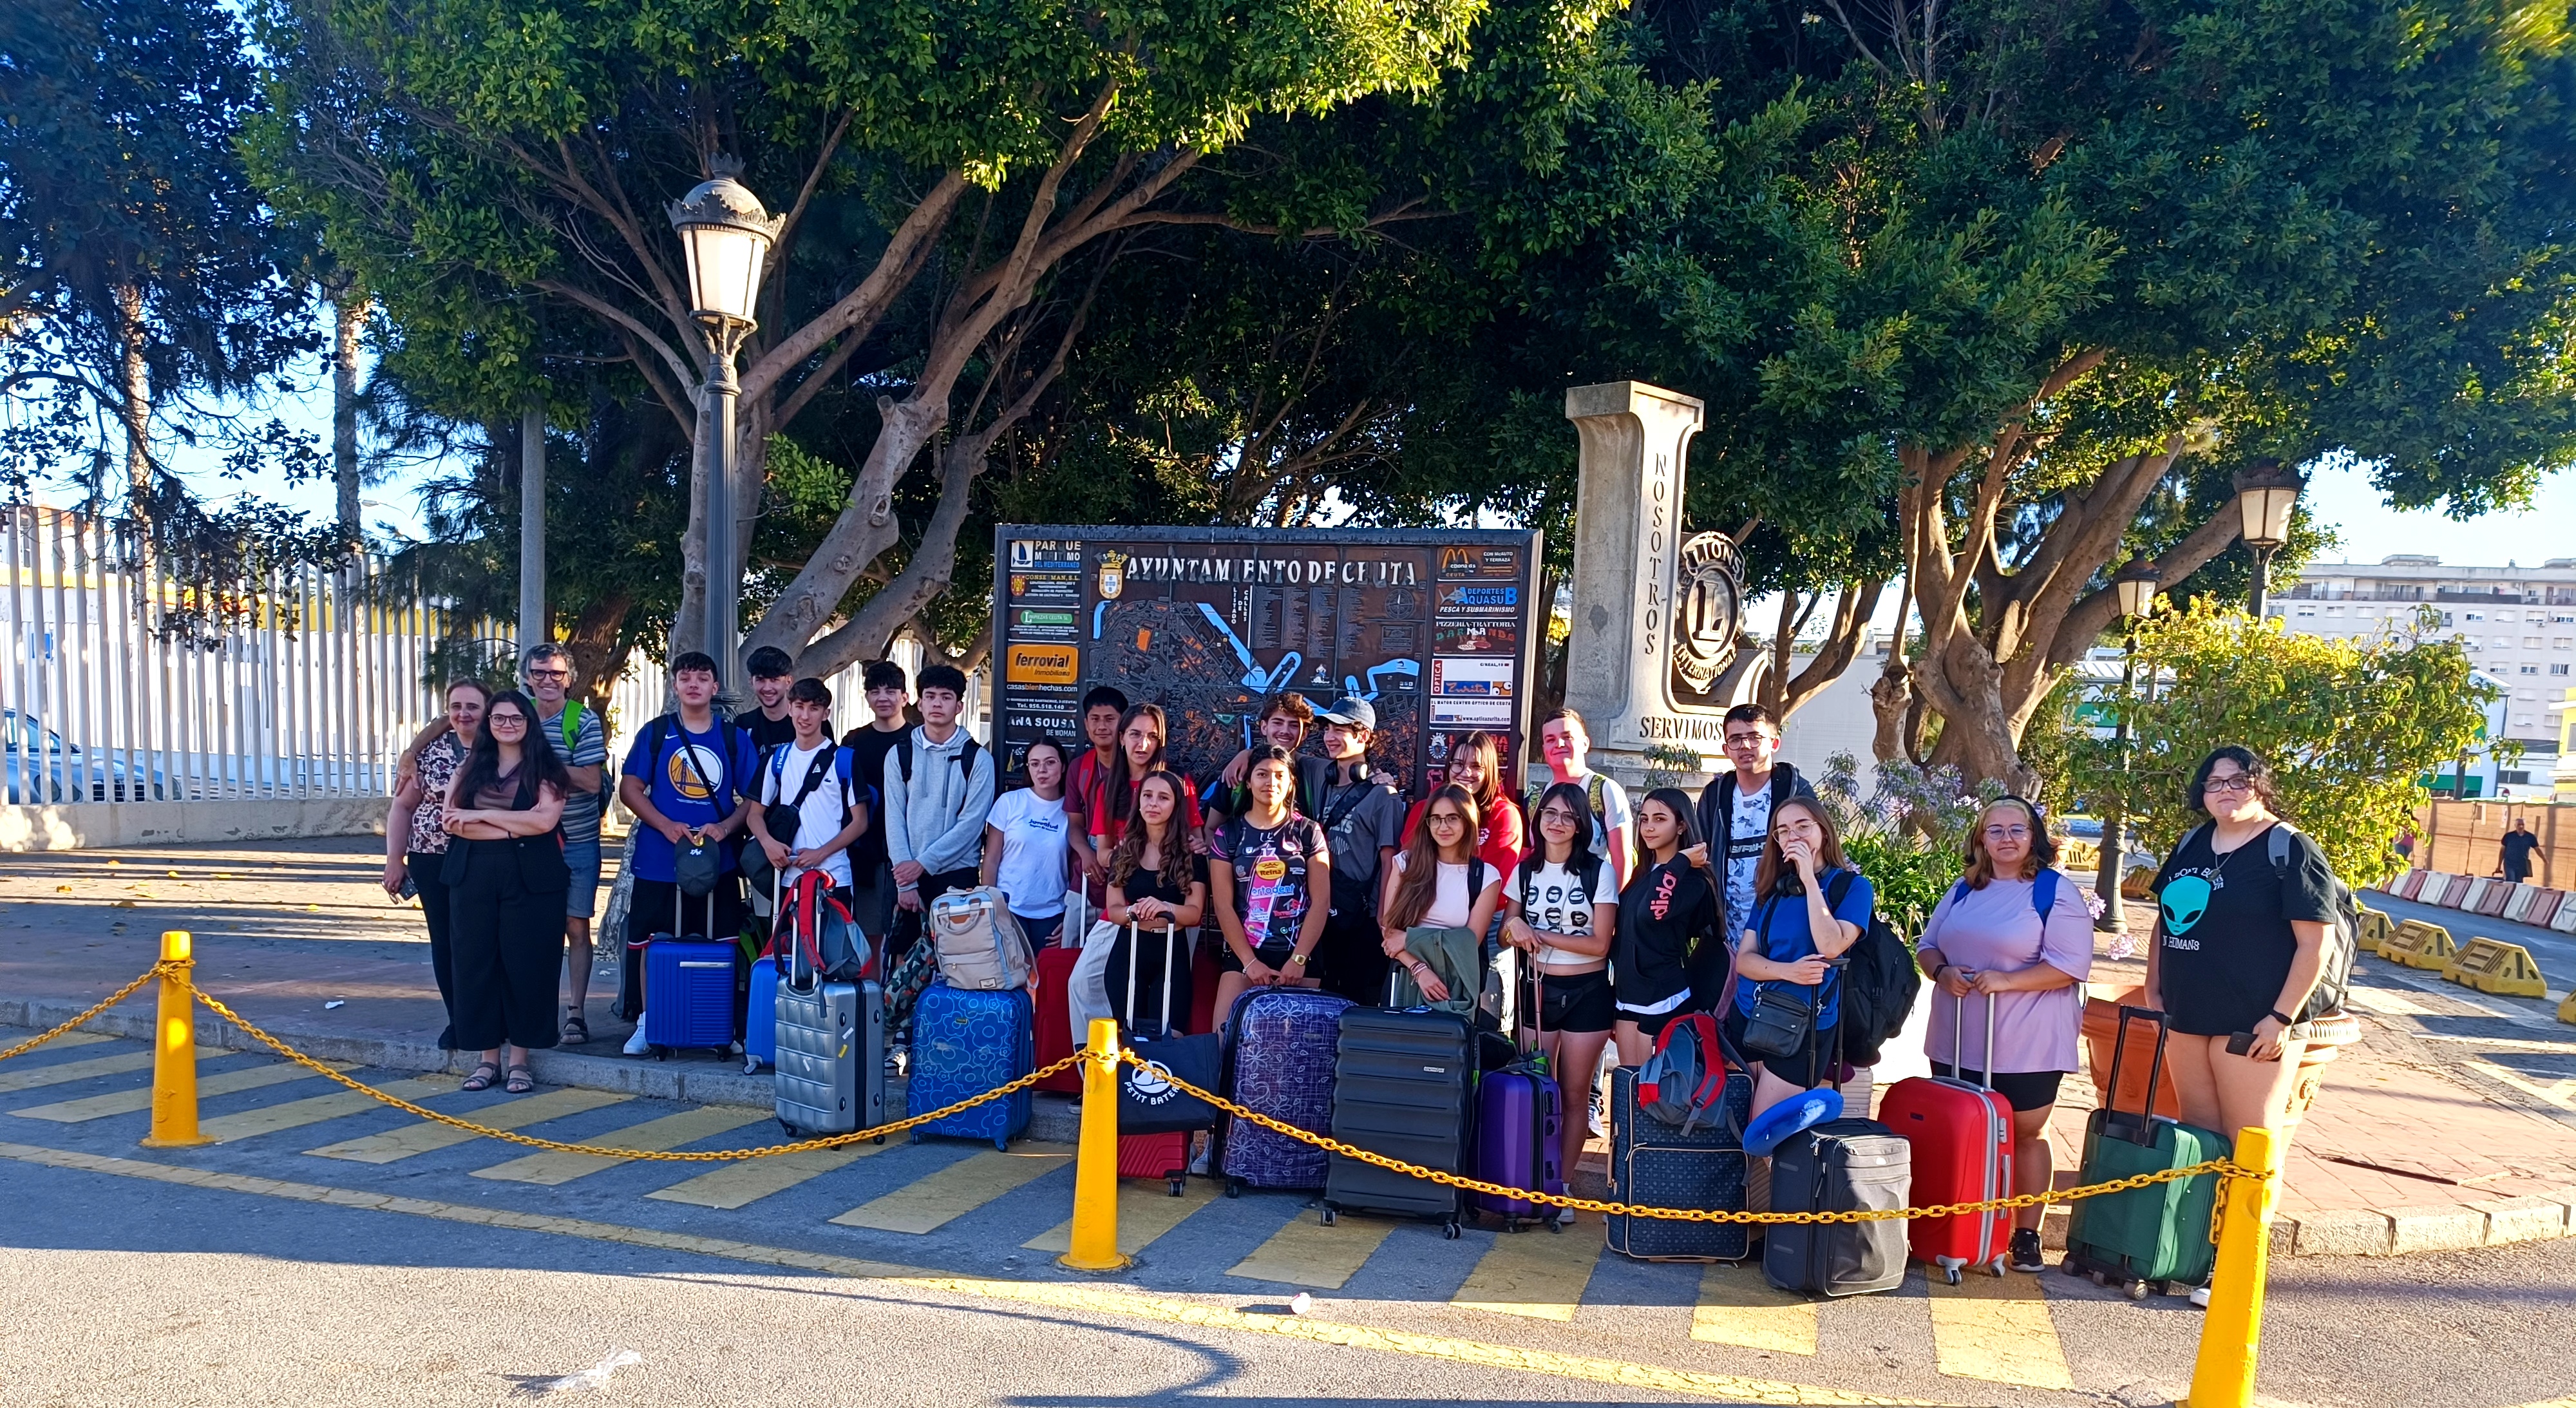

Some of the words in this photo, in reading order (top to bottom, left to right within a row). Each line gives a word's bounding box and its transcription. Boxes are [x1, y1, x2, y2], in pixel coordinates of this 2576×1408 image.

[1645, 453, 1667, 655] NOSOTROS
[1692, 540, 1742, 574] LIONS
[1126, 557, 1302, 584] AYUNTAMIENTO
[1307, 560, 1336, 585] DE
[1341, 561, 1416, 588] CEUTA
[1238, 600, 1243, 612] DE
[1692, 580, 1725, 642] L
[1016, 652, 1070, 668] ferrovial
[1675, 643, 1738, 680] INTERNATIONAL
[1007, 683, 1078, 692] casasbienhechas.com
[1445, 682, 1489, 693] Zurita
[1007, 716, 1032, 727] ANA
[1034, 717, 1075, 728] SOUSA
[1640, 716, 1723, 741] SERVIMOS
[1261, 847, 1276, 856] 17
[1251, 883, 1295, 895] ortodent
[2168, 936, 2201, 951] HUMANS
[1124, 1081, 1148, 1103] PETIT
[1150, 1083, 1181, 1105] BATEA
